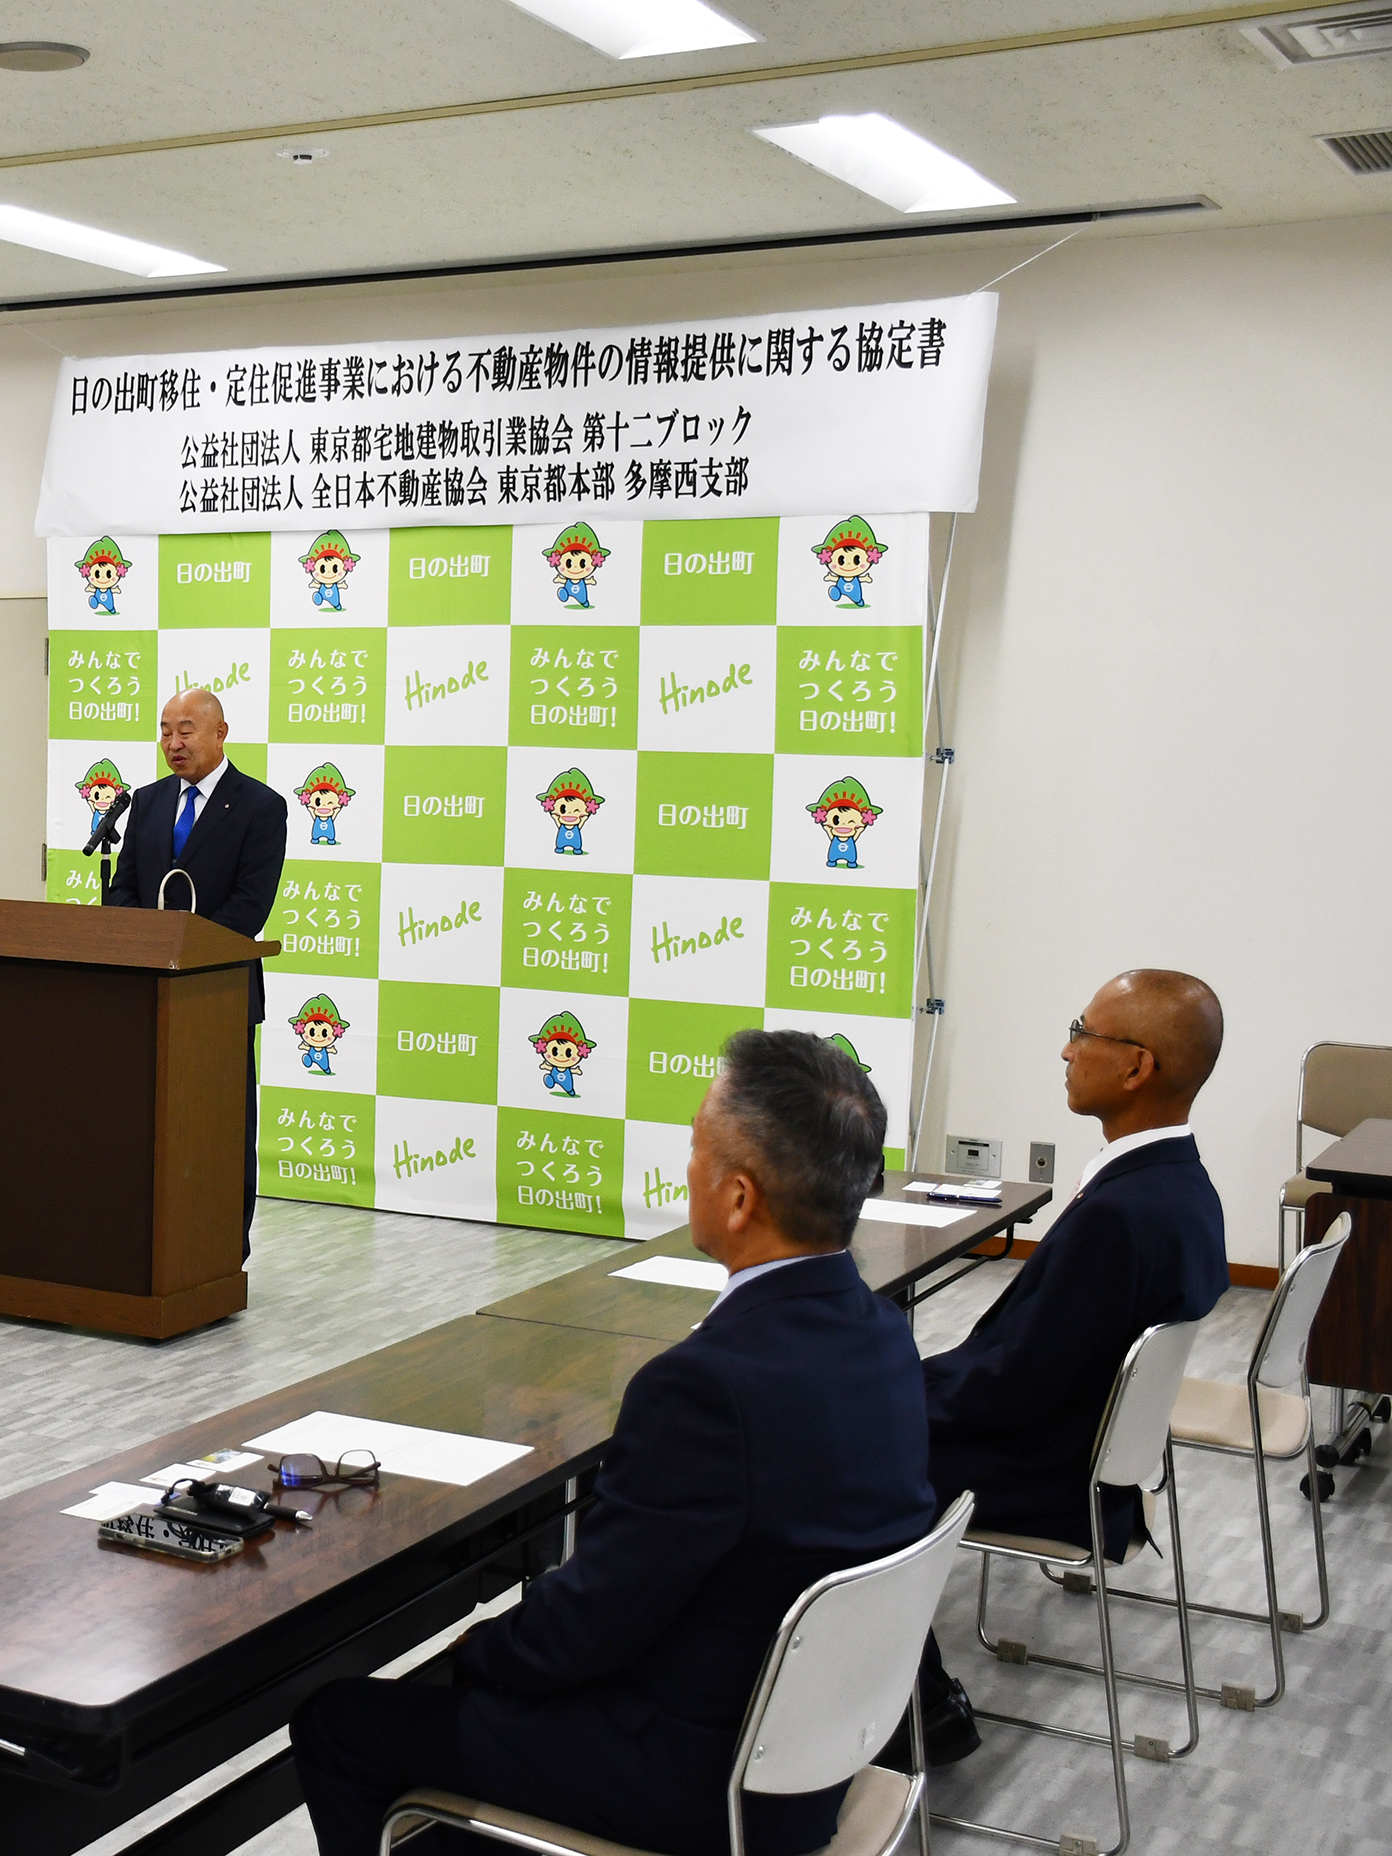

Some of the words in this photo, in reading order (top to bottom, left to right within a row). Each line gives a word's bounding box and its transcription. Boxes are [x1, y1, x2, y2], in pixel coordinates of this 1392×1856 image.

[71, 317, 947, 416] 日の出町移住・定住促進事業における不動産物件の情報提供に関する協定書
[181, 428, 301, 469] 公益社団法人
[309, 412, 574, 466] 東京都宅地建物取引業協会
[582, 405, 752, 453] 第十二ブロック
[179, 474, 304, 514] 公益社団法人
[311, 465, 488, 509] 全日本不動産協会
[497, 460, 615, 505] 東京都本部
[624, 455, 750, 501] 多摩西支部
[176, 560, 252, 584] 日の出町
[409, 554, 491, 580] 日の出町
[664, 550, 755, 576] 日の出町
[68, 650, 141, 670] みんなで
[288, 649, 369, 669] みんなで
[530, 647, 619, 669] みんなで
[798, 649, 898, 672] みんなで
[68, 675, 141, 696] つくろう
[288, 675, 367, 697] つくろう
[405, 660, 489, 711] Hinode
[530, 676, 618, 699] つくろう
[659, 663, 753, 715] Hinode
[799, 679, 897, 703] つくろう
[403, 794, 486, 819] 日の出町
[658, 803, 749, 830] 日の出町
[282, 880, 363, 902] みんなで
[523, 890, 612, 916] みんなで
[282, 907, 361, 930] つくろう
[398, 900, 482, 947] Hinode
[790, 906, 890, 933] みんなで
[523, 920, 610, 945] つくろう
[651, 916, 744, 963] Hinode
[790, 937, 887, 963] つくろう
[397, 1030, 478, 1057] 日の出町
[277, 1108, 357, 1133] みんなで
[277, 1136, 356, 1160] つくろう
[516, 1130, 604, 1158] みんなで
[393, 1136, 476, 1179] Hinode
[516, 1159, 604, 1186] つくろう
